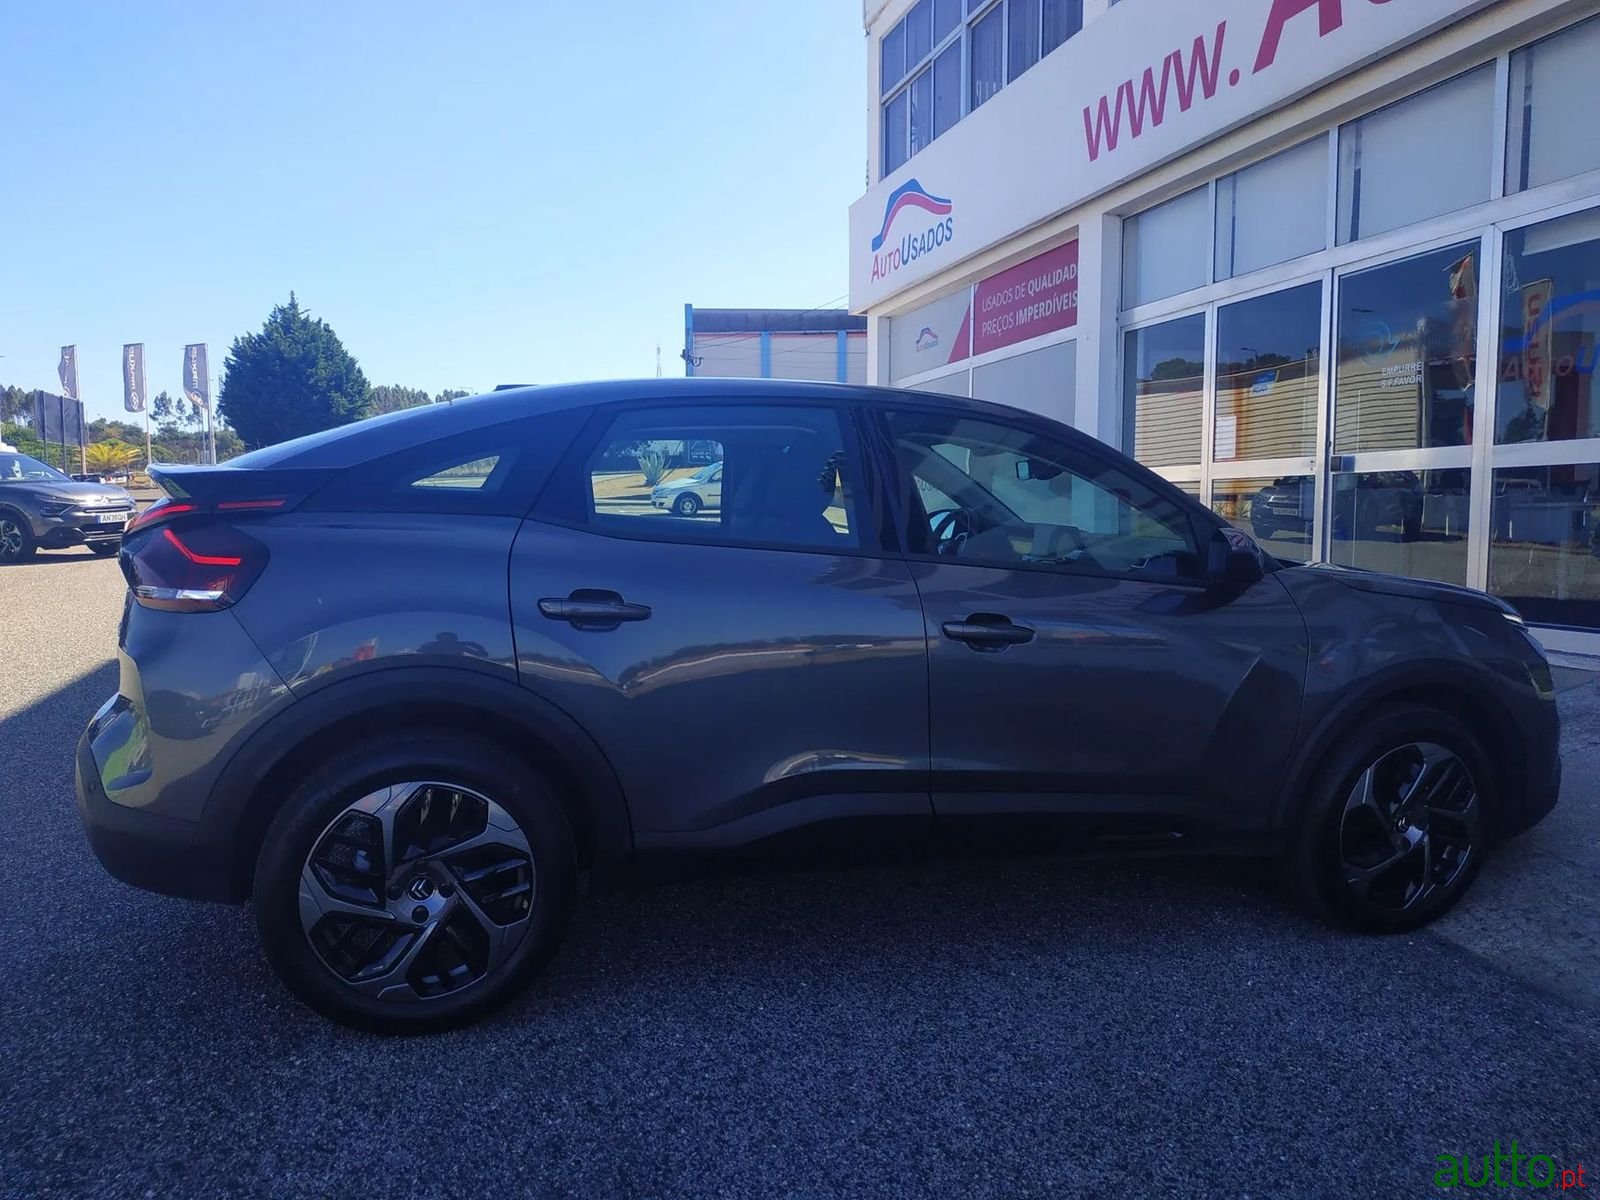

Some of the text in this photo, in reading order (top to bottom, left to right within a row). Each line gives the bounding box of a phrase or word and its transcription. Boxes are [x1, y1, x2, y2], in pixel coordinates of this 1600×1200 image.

[981, 263, 1078, 312] USADOS DE QUALIDAD
[981, 290, 1078, 337] PREÇOS IMPERDÍVEIS
[1381, 361, 1422, 376] EMPURRE
